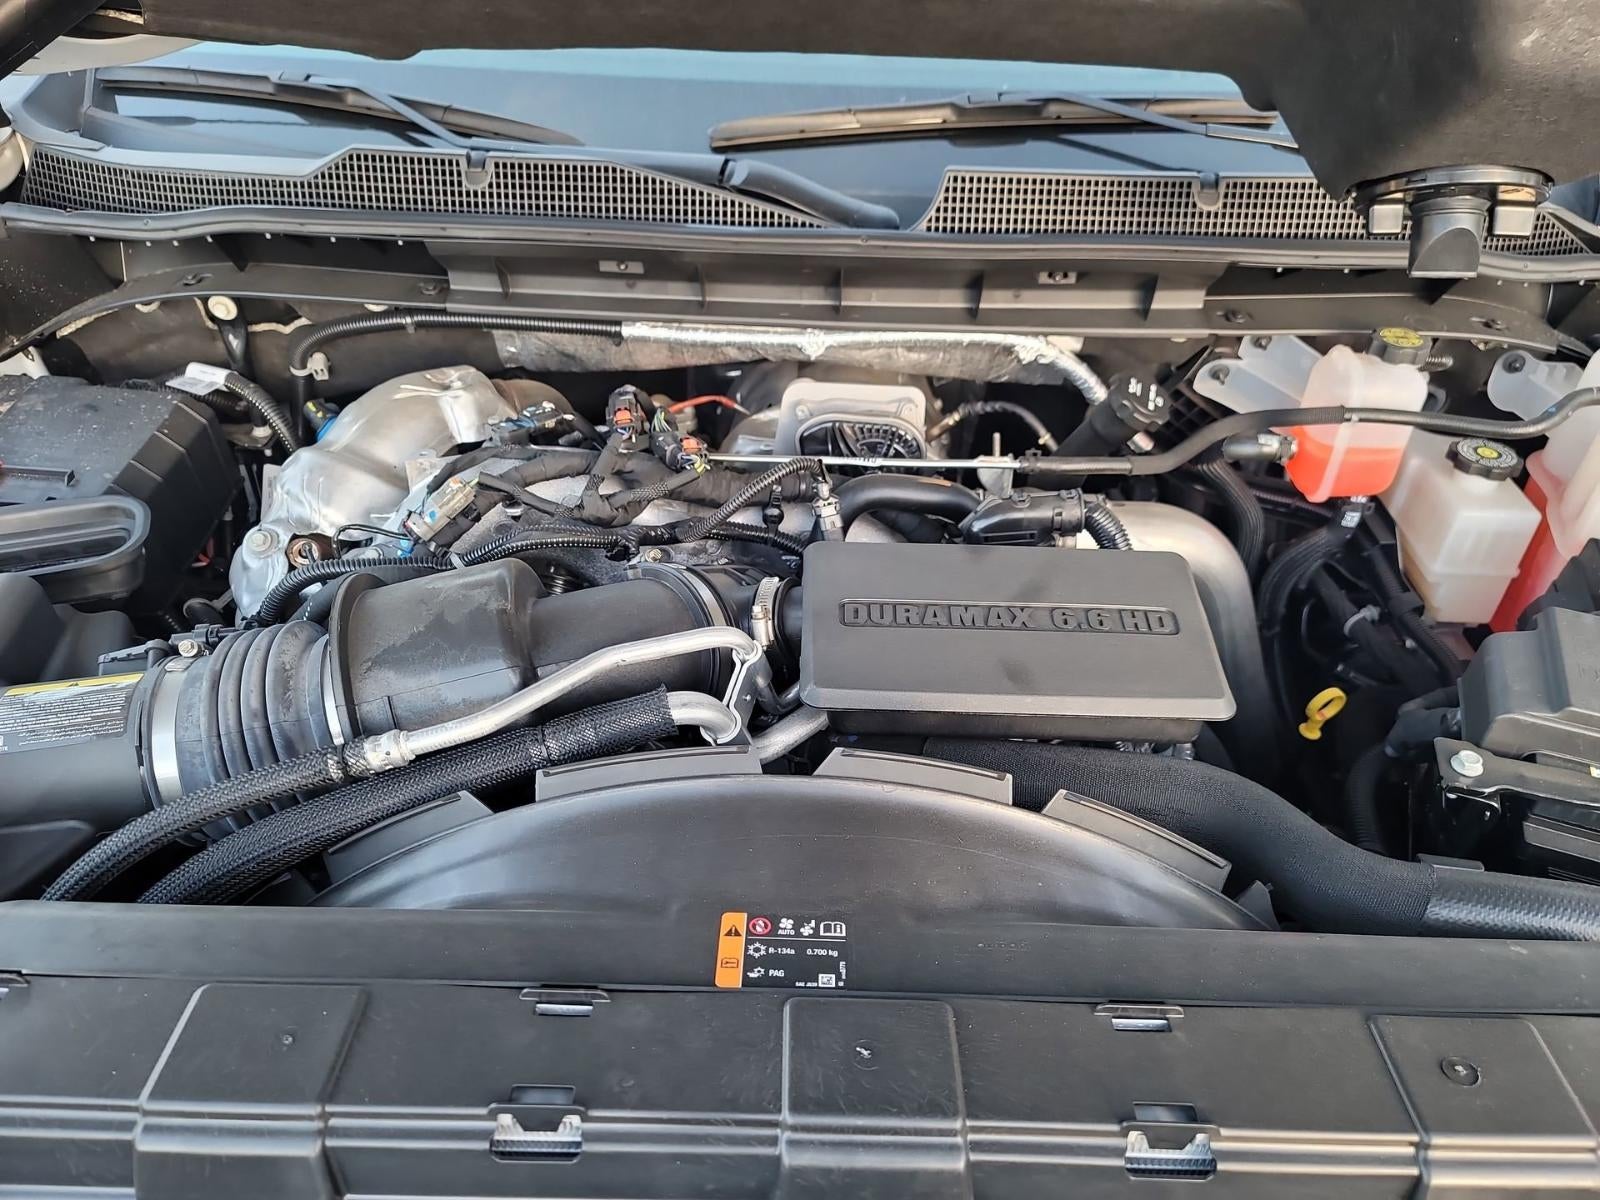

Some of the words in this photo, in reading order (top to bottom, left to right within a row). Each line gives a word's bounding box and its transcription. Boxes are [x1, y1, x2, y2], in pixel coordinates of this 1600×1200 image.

[843, 602, 1036, 629] DURAMAX
[1051, 607, 1114, 632] 6.6
[1120, 608, 1176, 634] HD
[768, 947, 796, 955] R-134a
[806, 948, 828, 956] 0.700
[828, 948, 839, 957] kg
[768, 969, 785, 977] PAG
